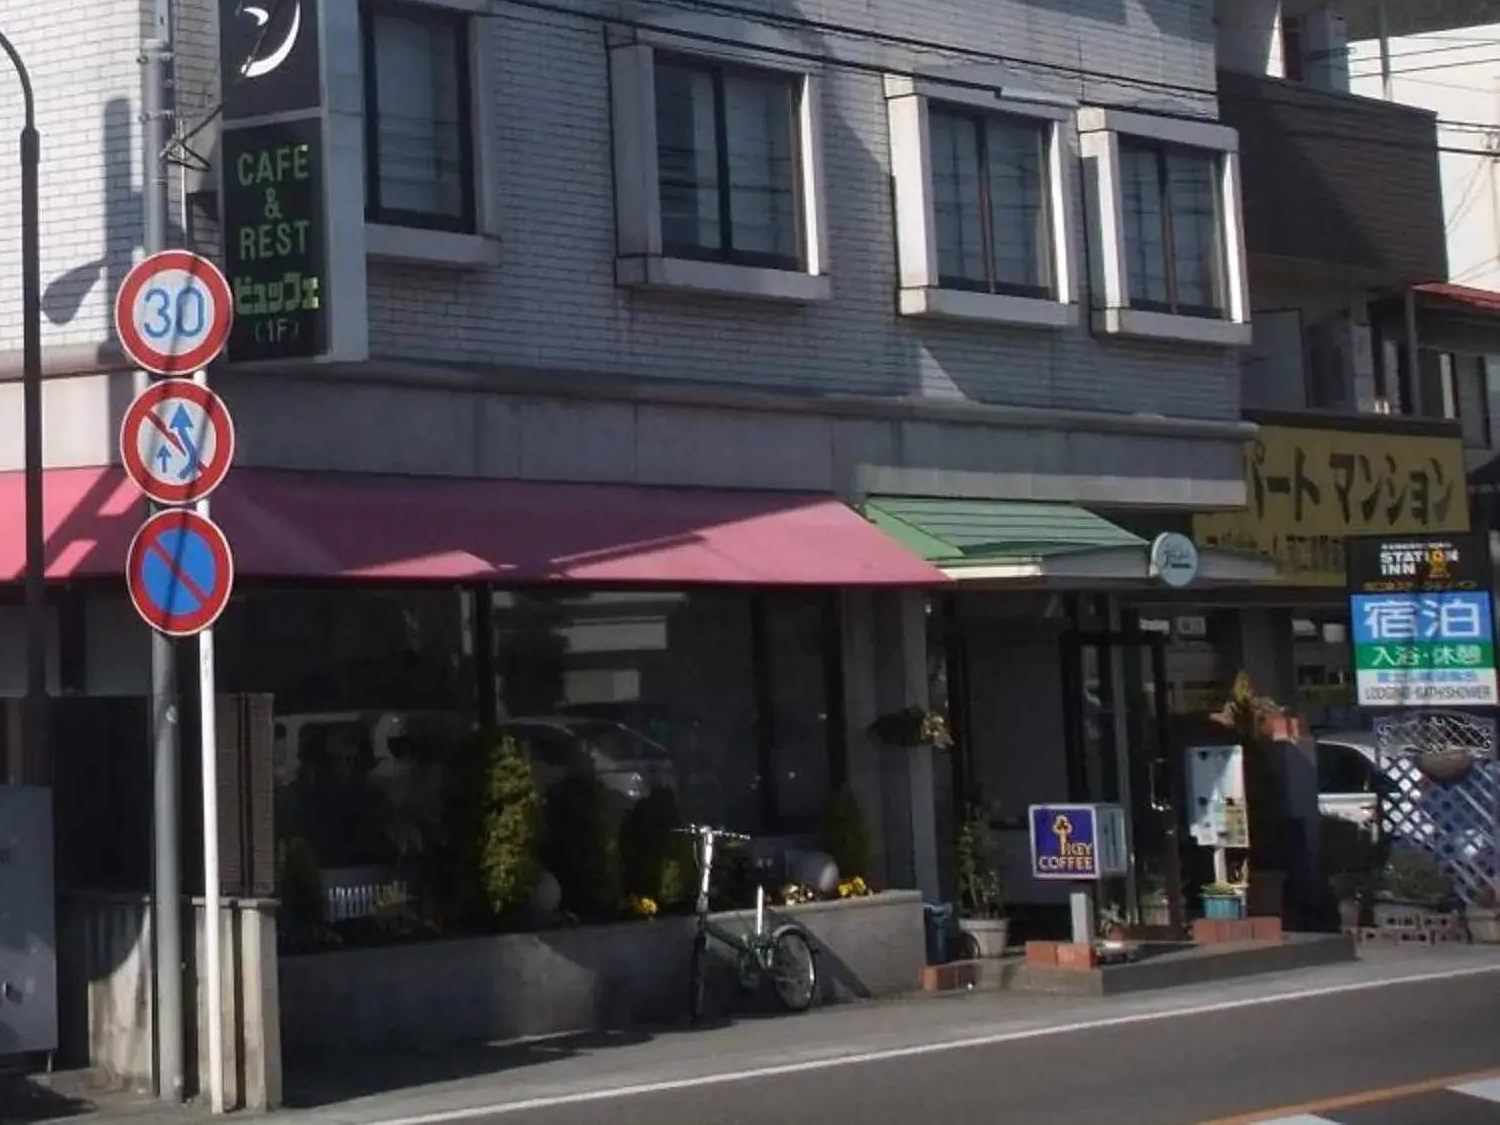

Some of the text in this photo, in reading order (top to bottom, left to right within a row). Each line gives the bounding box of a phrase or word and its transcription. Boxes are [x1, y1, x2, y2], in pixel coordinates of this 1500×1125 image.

[237, 144, 309, 187] CAFE
[264, 187, 283, 219] &
[239, 220, 311, 261] REST
[143, 286, 206, 339] 30
[235, 272, 320, 315] ビュッフェ
[1381, 563, 1417, 575] INN
[1363, 598, 1481, 639] 宿泊
[1038, 855, 1093, 871] COFFEE
